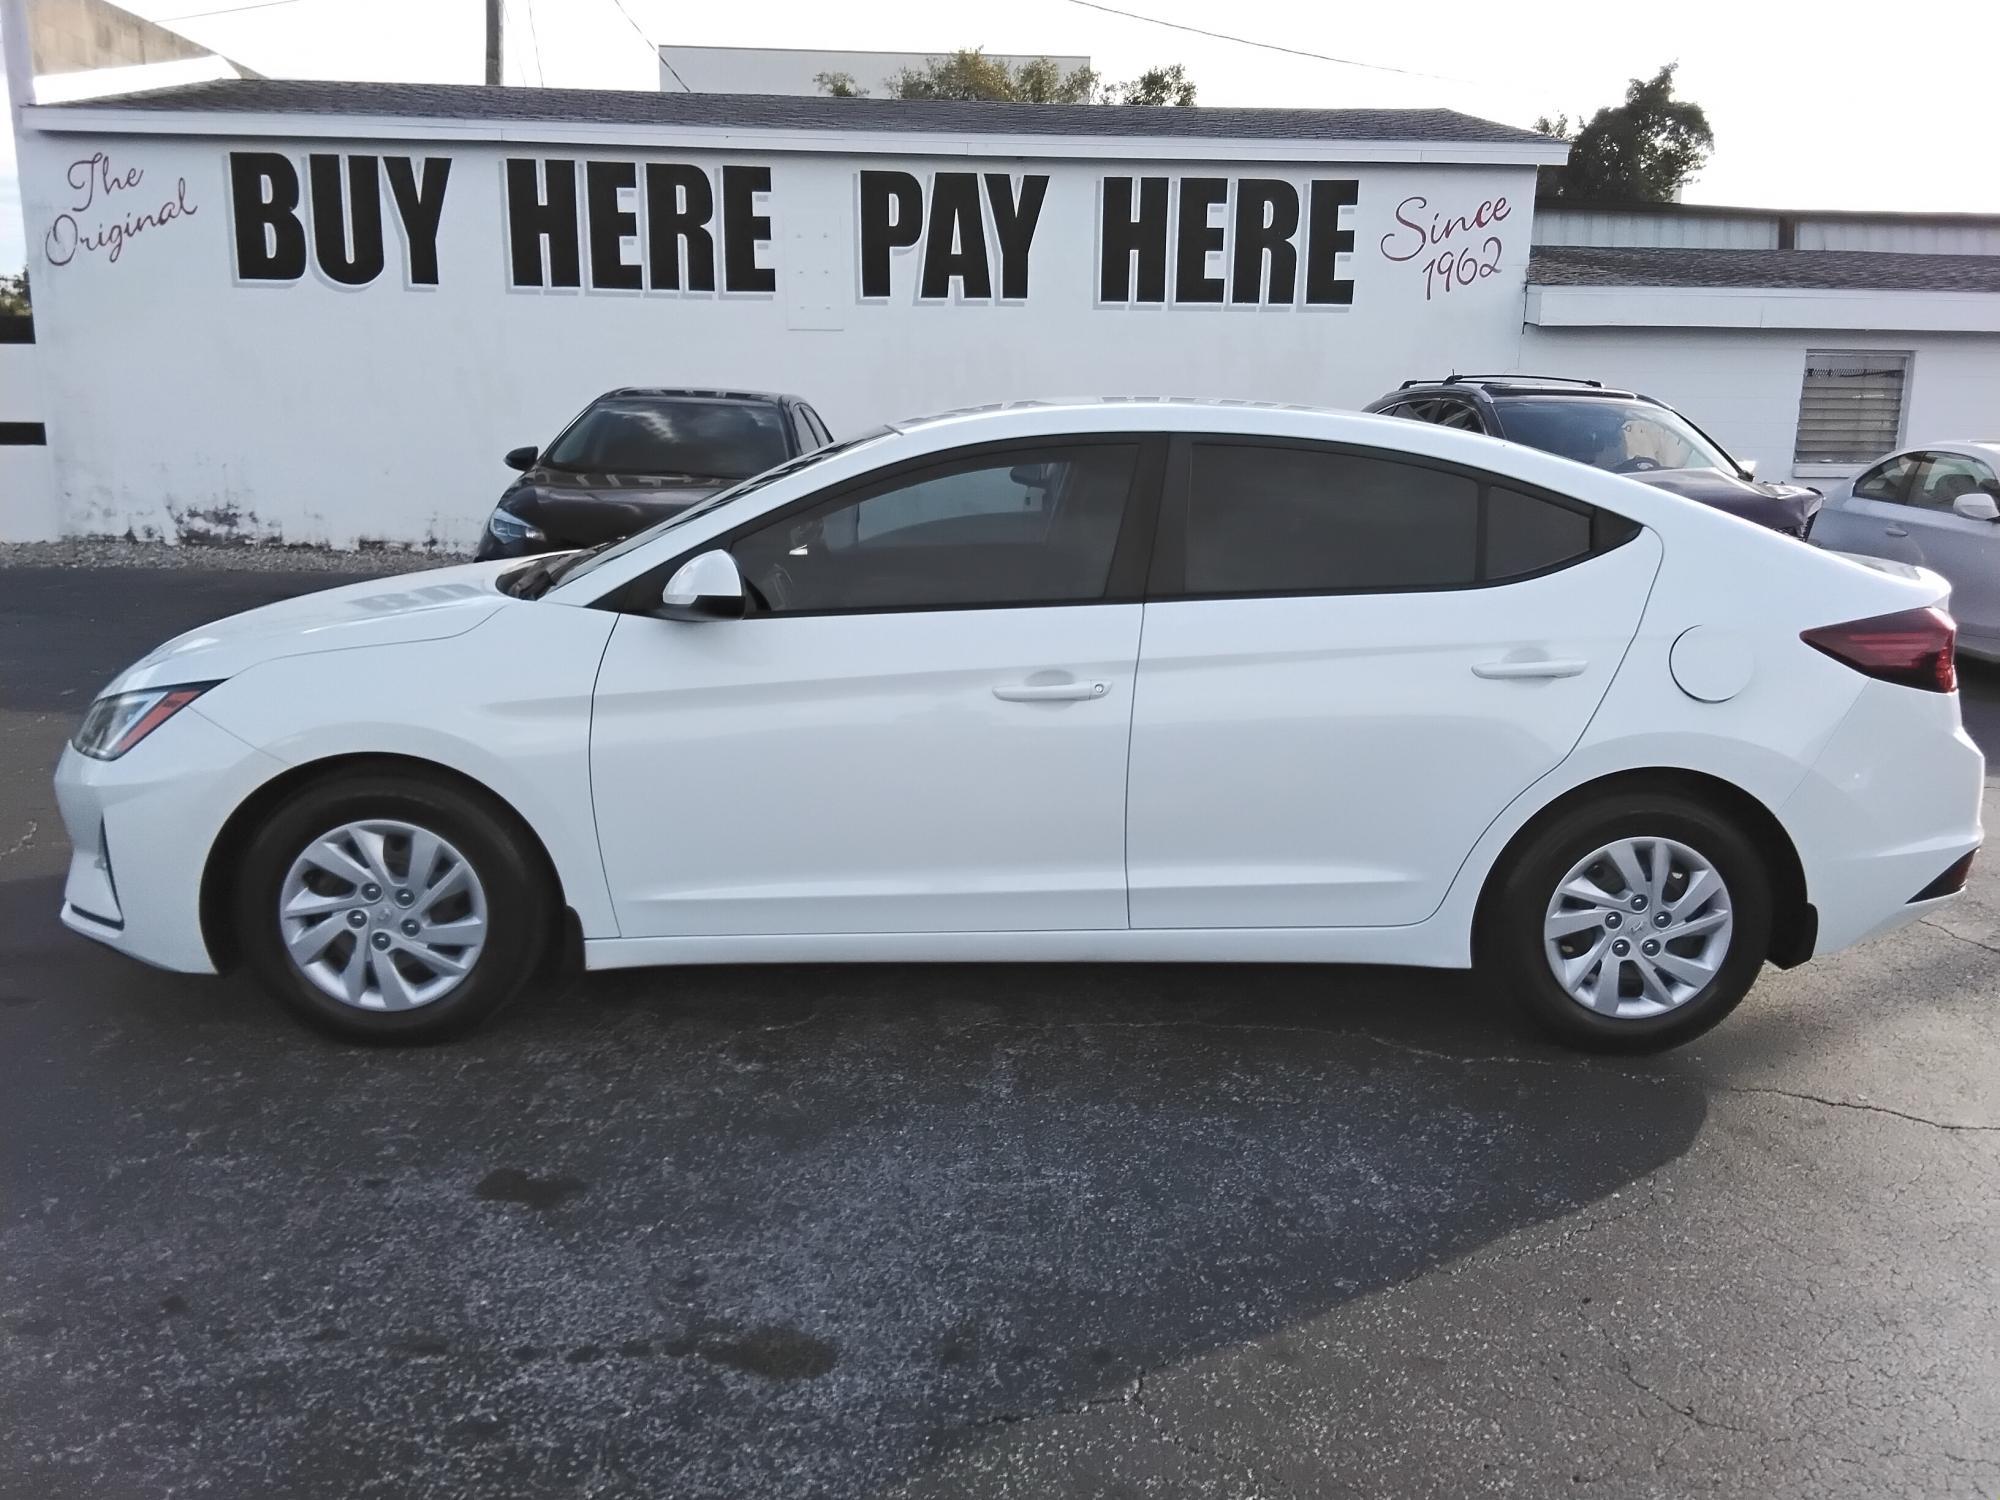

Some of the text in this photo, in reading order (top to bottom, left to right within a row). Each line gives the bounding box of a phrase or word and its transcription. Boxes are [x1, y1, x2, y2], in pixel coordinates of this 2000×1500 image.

[67, 152, 144, 212] The
[45, 176, 198, 266] Original
[229, 151, 1360, 305] BUY HERE PAY HERE
[1380, 196, 1512, 262] Since
[1422, 236, 1503, 301] 1962
